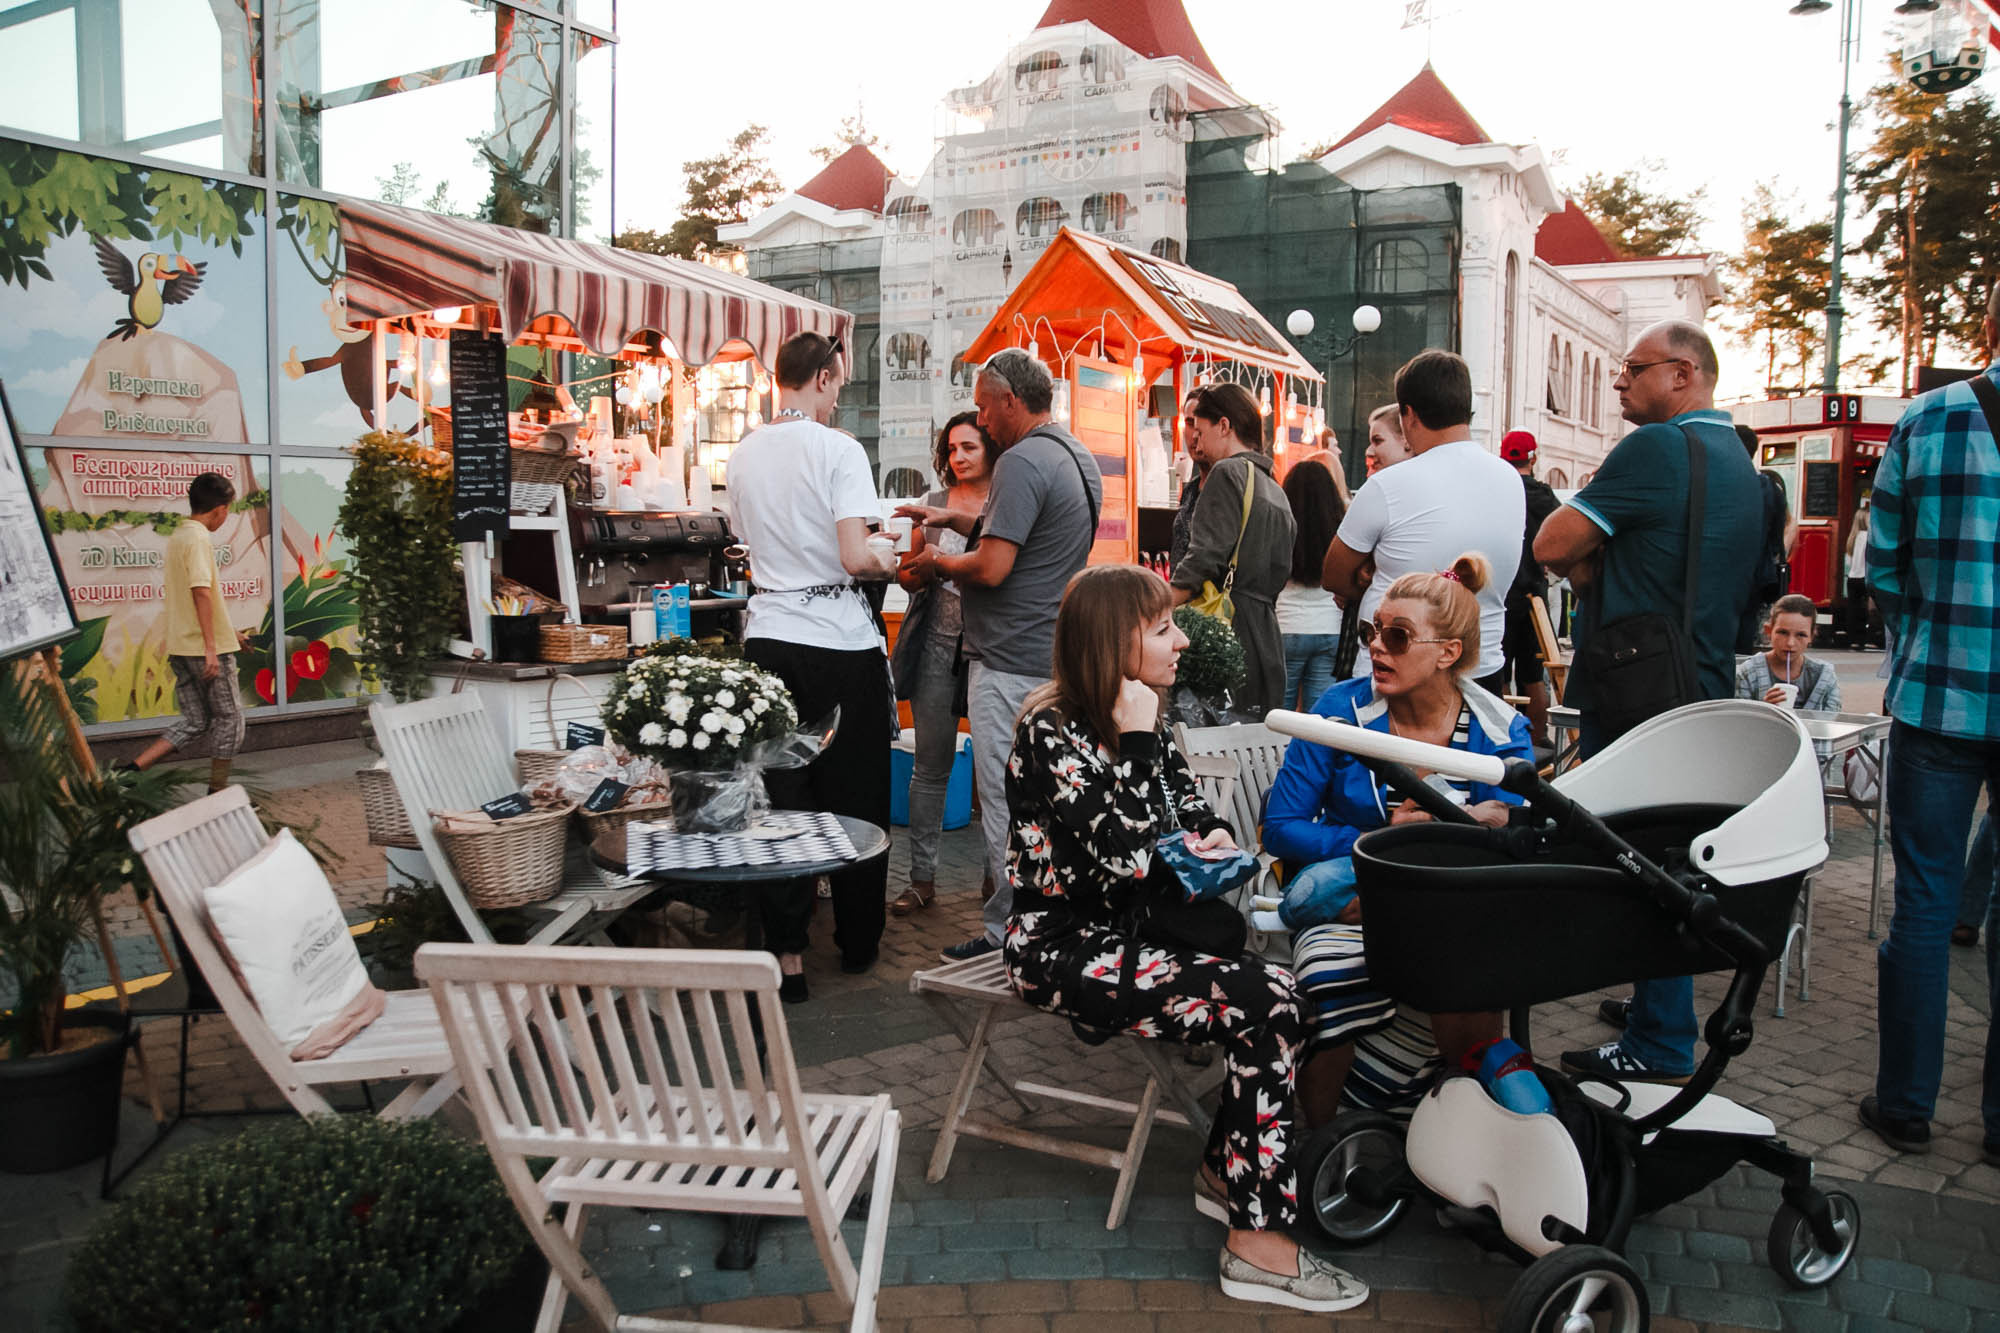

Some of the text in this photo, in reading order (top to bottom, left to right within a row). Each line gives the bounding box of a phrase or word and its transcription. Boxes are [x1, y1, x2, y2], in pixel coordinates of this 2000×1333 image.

[1084, 82, 1133, 97] CAPAROL
[108, 371, 201, 397] Игротека
[1829, 400, 1839, 418] 9
[1848, 399, 1858, 418] 9
[104, 409, 207, 434] Рыбалочка
[72, 453, 234, 479] Беспроигрышные
[83, 479, 191, 498] аттракцио
[130, 584, 152, 599] на
